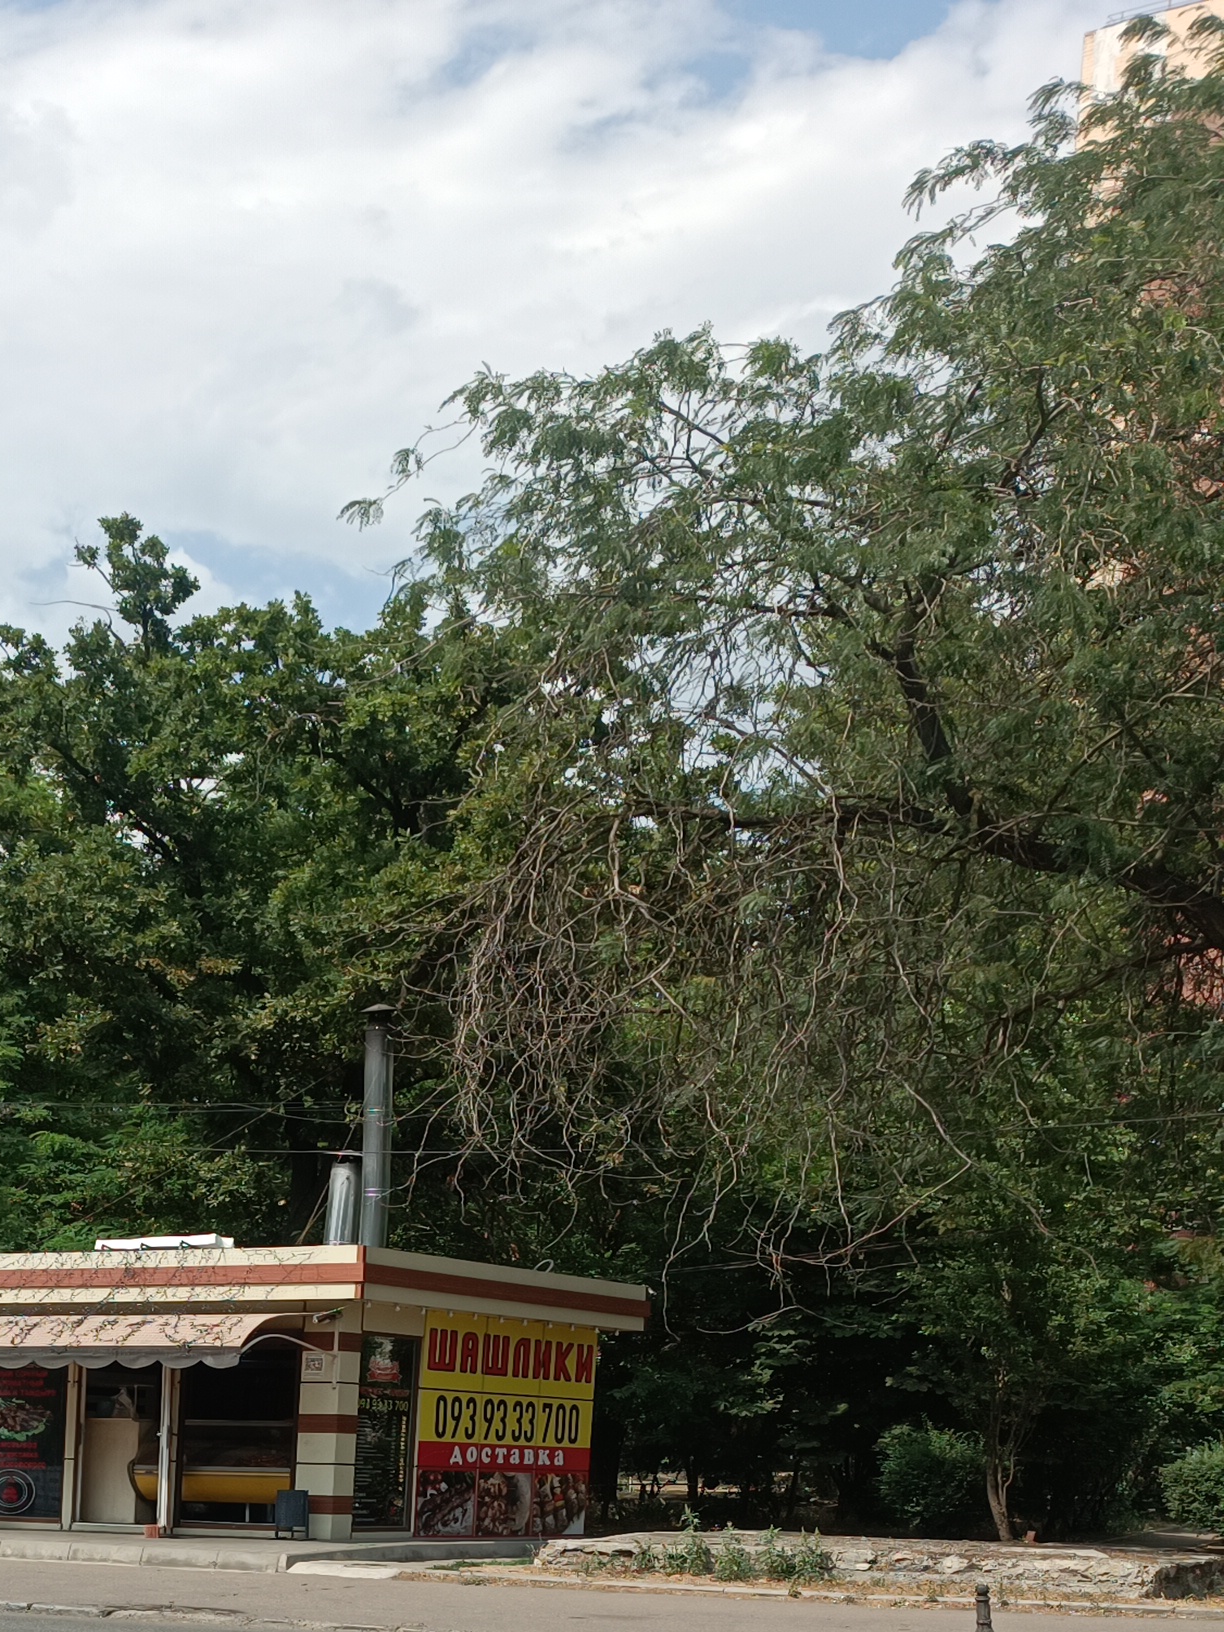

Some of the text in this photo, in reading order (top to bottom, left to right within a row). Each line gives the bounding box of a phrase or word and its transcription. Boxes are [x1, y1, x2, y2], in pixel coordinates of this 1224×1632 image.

[426, 1327, 594, 1384] ШАШЛИКИ
[434, 1393, 580, 1444] 093 93 33 700
